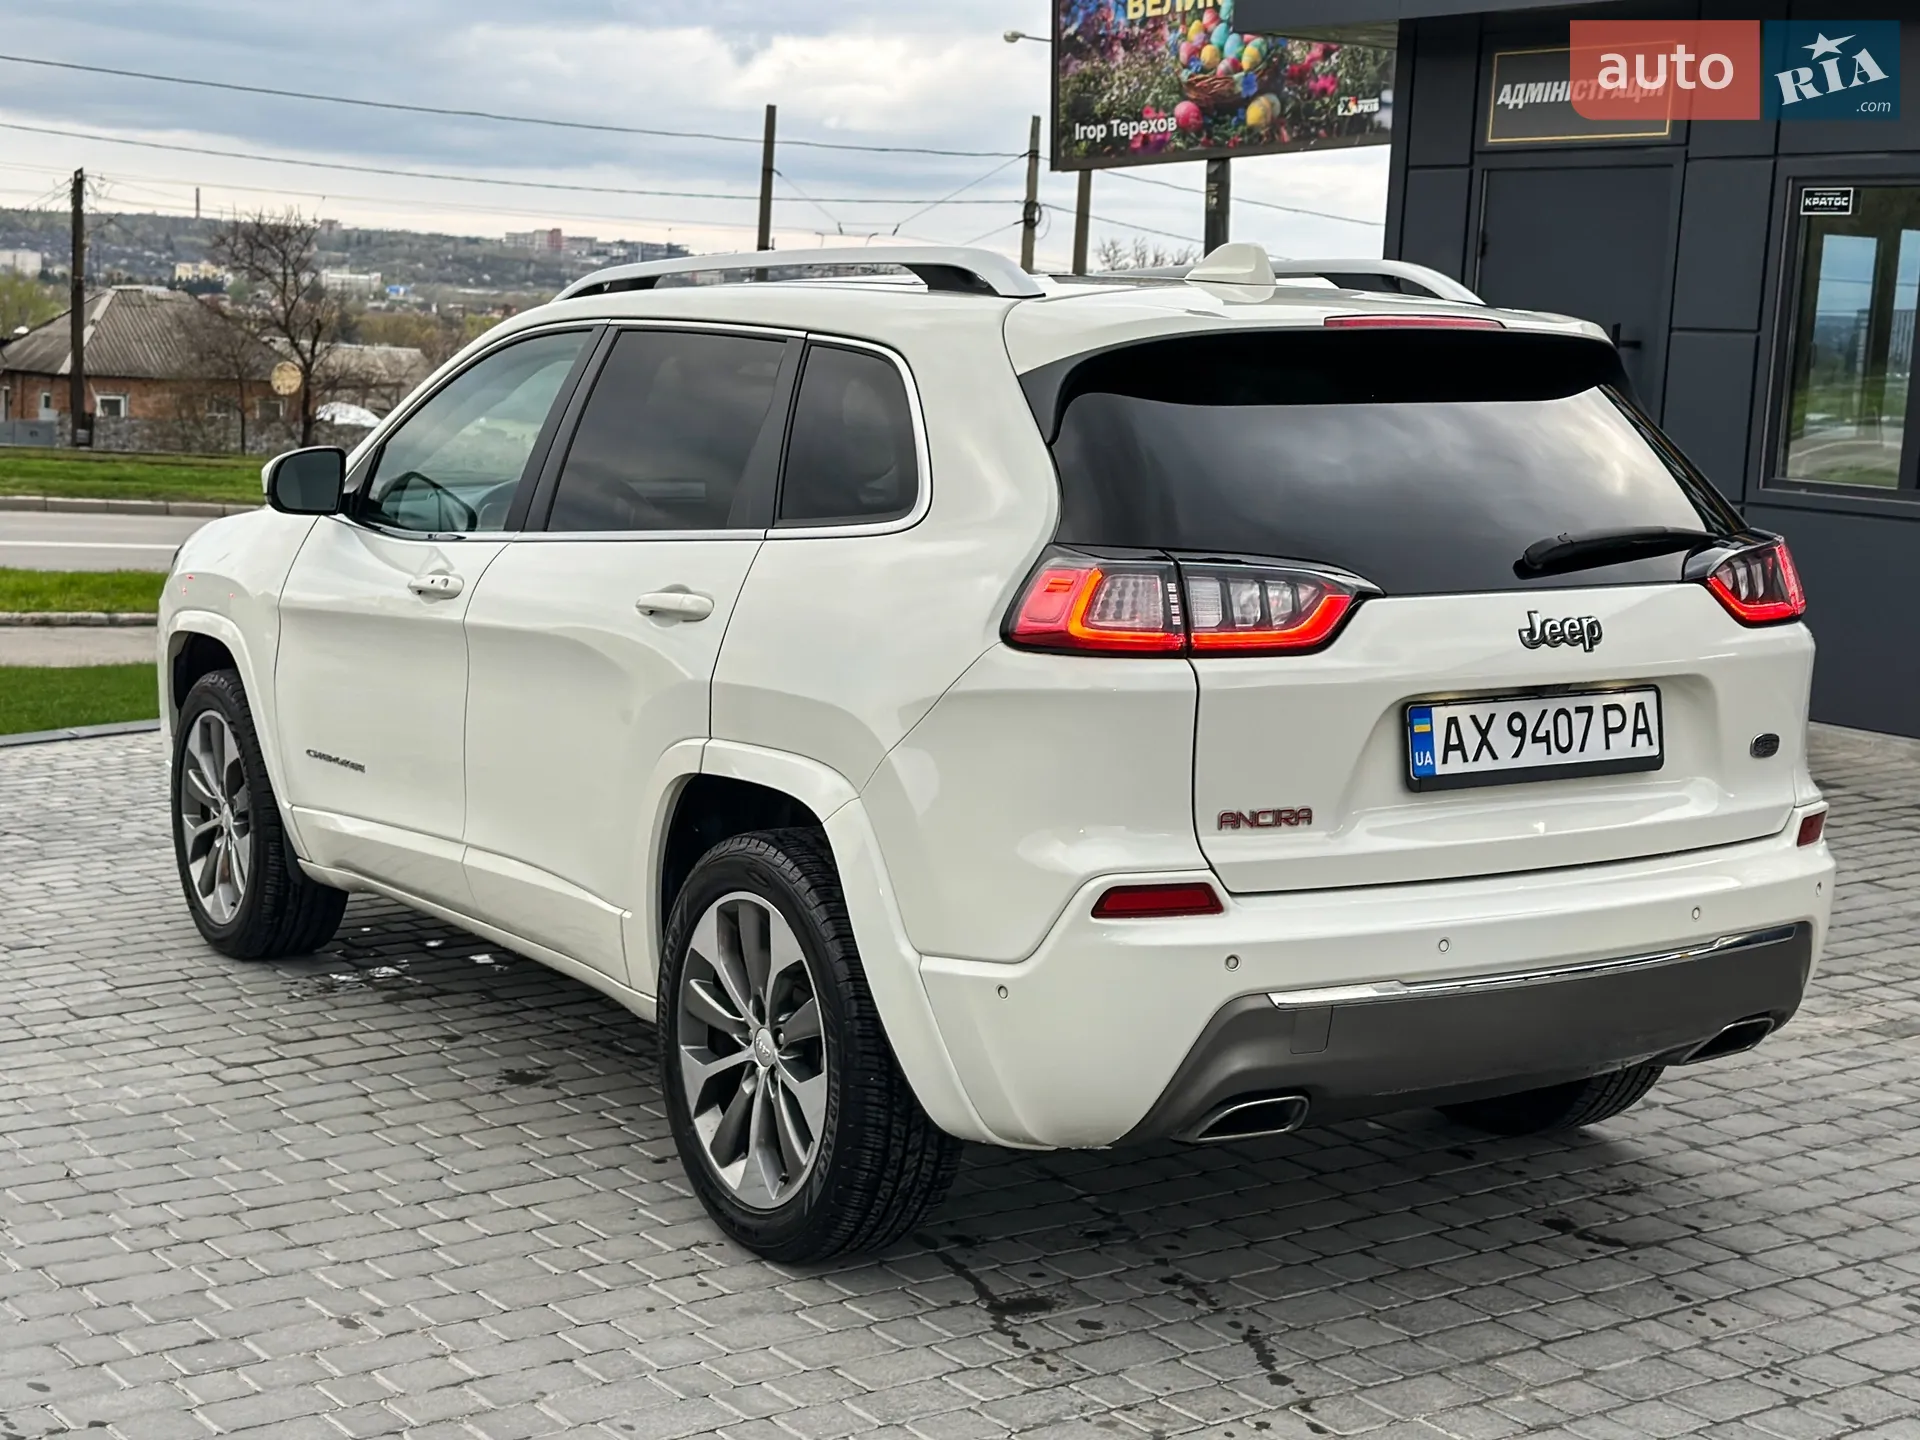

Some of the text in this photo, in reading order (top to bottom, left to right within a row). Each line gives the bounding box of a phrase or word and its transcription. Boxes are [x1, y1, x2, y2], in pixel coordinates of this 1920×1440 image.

[1075, 118, 1177, 143] Ігор Терехов
[1804, 197, 1849, 206] КРАТОС
[1518, 610, 1603, 652] Jeep
[1441, 701, 1654, 765] AX 9407 PA
[1415, 751, 1434, 767] UA
[1217, 808, 1313, 831] ANCIRA
